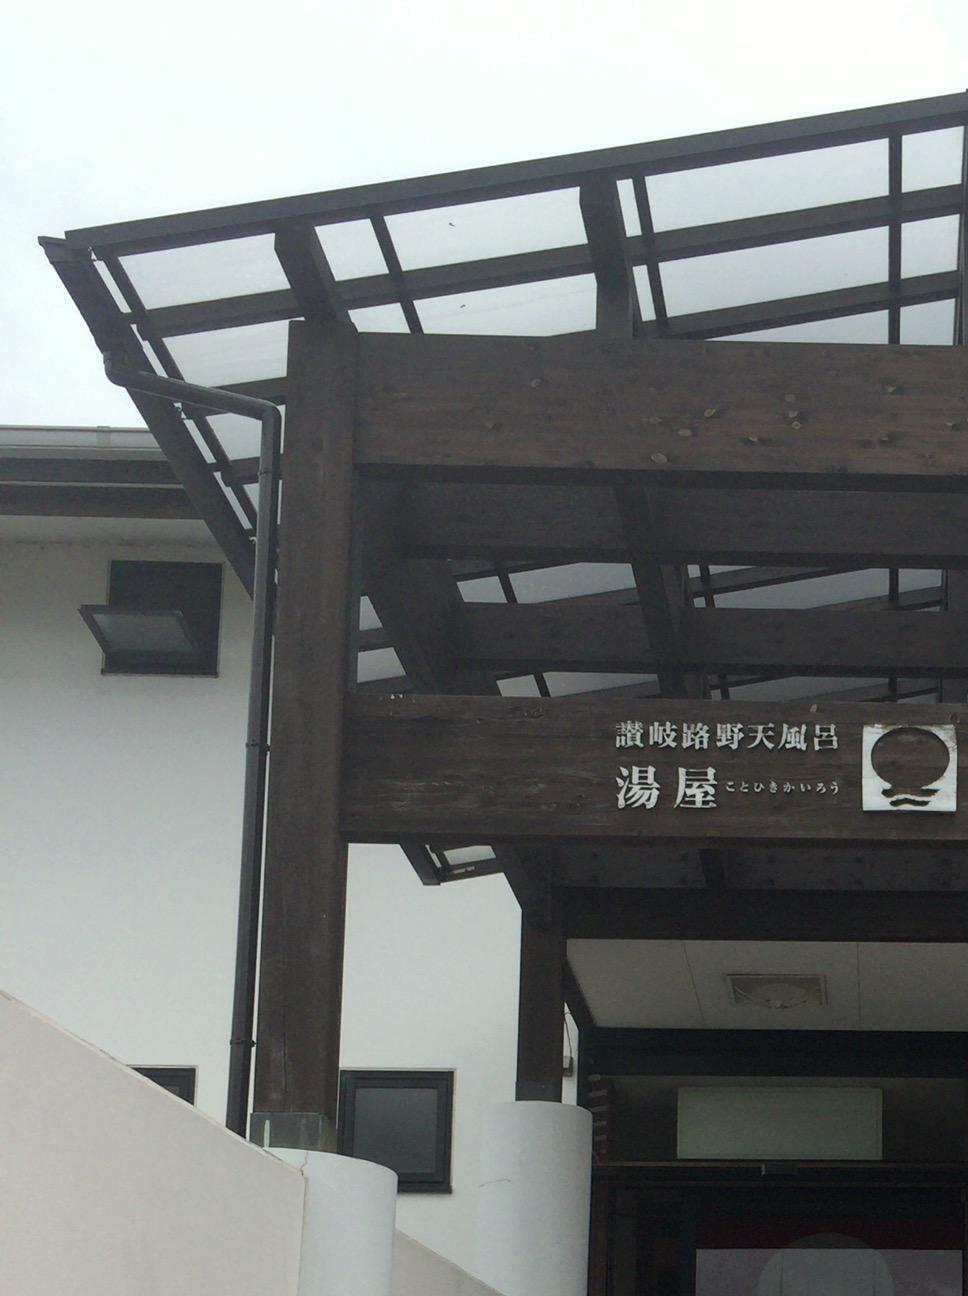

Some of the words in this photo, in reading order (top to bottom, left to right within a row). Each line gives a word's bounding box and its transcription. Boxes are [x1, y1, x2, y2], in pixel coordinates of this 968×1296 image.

[616, 765, 718, 809] 湯屋
[726, 780, 839, 795] ことひきかいろう
